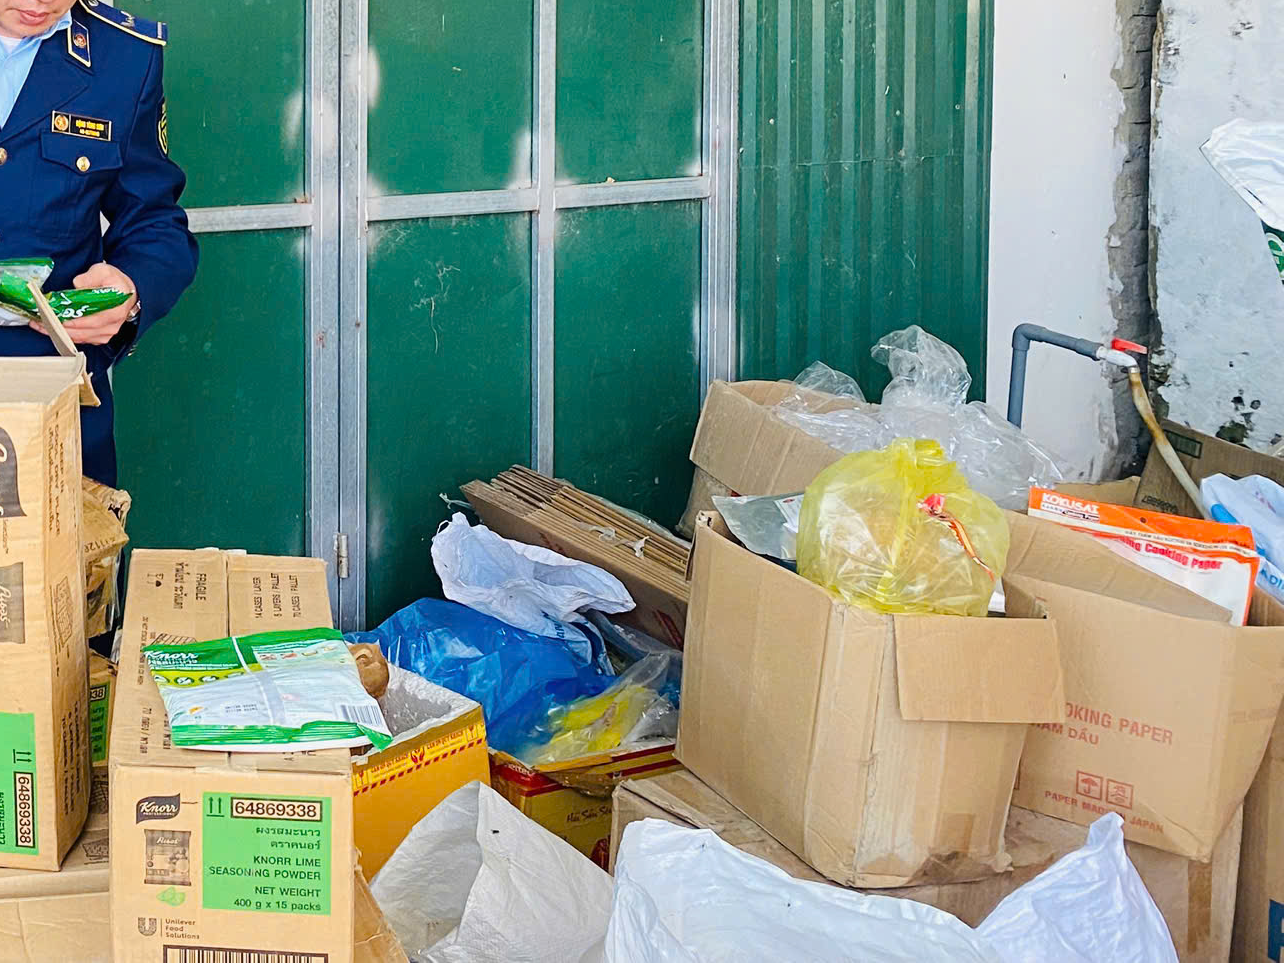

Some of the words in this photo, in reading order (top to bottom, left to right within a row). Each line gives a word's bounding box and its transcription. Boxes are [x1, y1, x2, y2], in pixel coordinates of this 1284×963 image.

[1042, 492, 1100, 513] KOKUSAI
[1145, 543, 1189, 566] Cooking
[1191, 558, 1223, 570] Paper
[1066, 703, 1112, 728] OKING
[1119, 718, 1172, 745] PAPER
[18, 776, 31, 843] 64869338
[140, 801, 178, 813] Knorr
[235, 801, 317, 818] 64869338
[1044, 791, 1077, 806] PAPER
[1130, 816, 1164, 833] JAPAN
[253, 856, 290, 866] KNORR
[295, 857, 321, 868] LIME
[209, 866, 270, 878] SEASONING
[274, 870, 321, 880] POWDER
[254, 886, 276, 896] NET
[279, 887, 322, 897] WEIGHT
[234, 898, 253, 908] 400
[255, 901, 262, 910] g
[276, 900, 287, 909] 15
[290, 901, 321, 912] packs
[166, 918, 196, 926] Unilever
